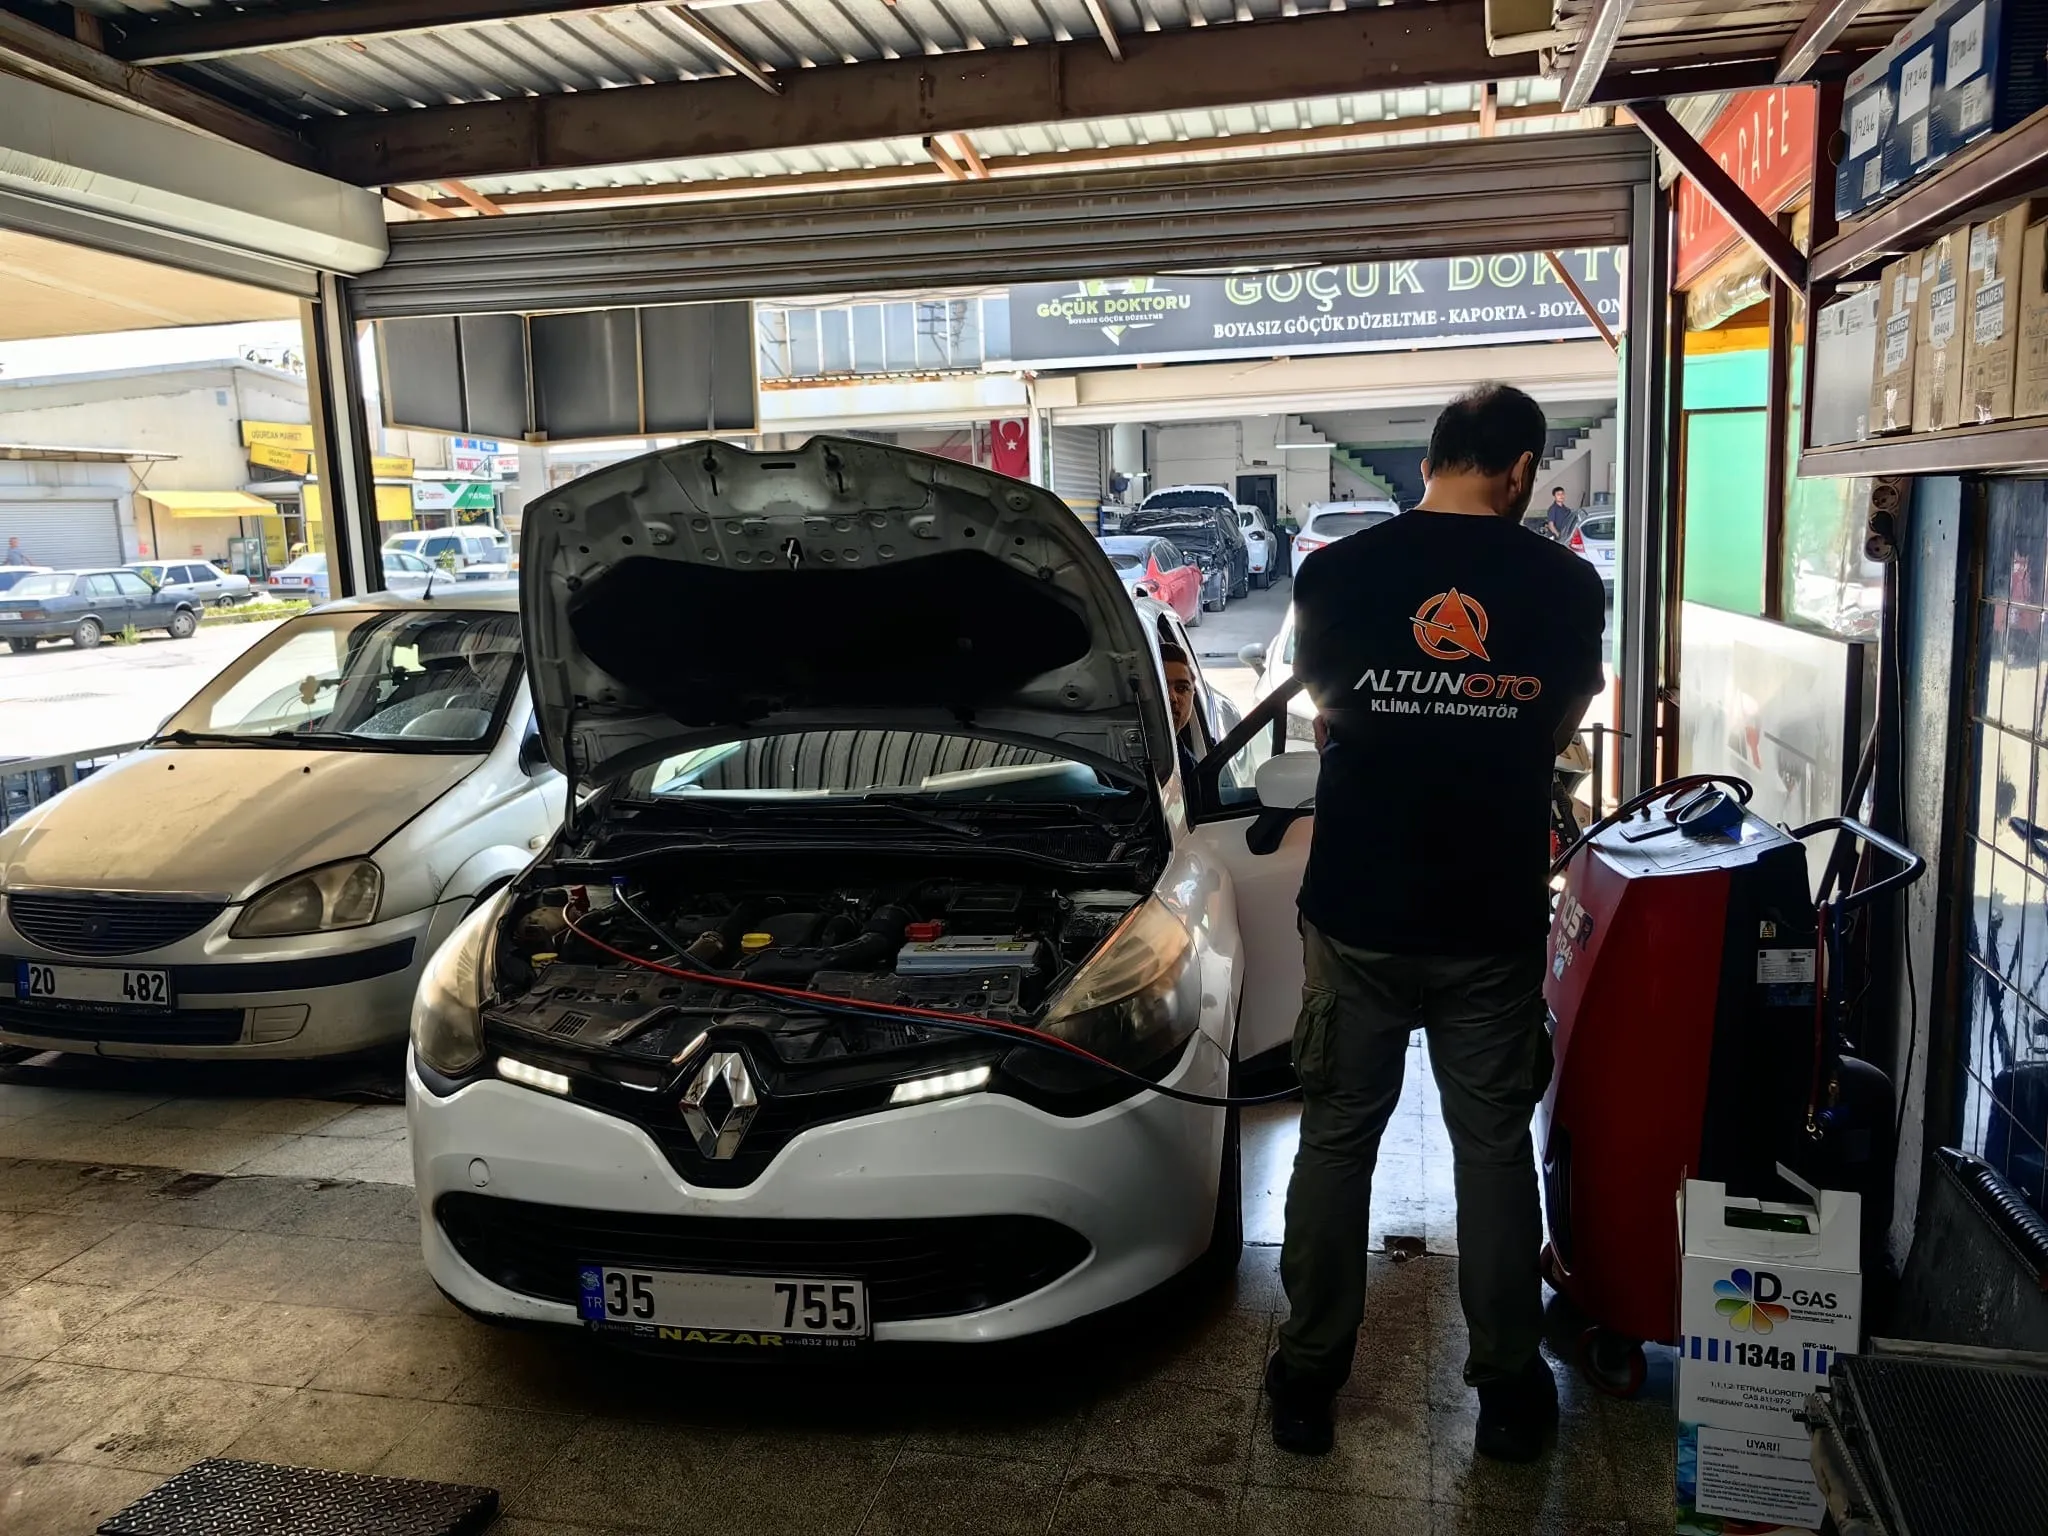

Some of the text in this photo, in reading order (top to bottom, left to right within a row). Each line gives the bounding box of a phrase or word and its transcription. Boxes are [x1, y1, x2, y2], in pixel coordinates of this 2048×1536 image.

[1036, 294, 1191, 320] GÖÇÜK DOKTORU
[1068, 313, 1164, 325] BOYASIZ GÖÇÜK DÜZELTME
[1213, 319, 1282, 338] BOYASIZ
[1284, 314, 1345, 337] GÖÇÜK
[1347, 310, 1437, 330] DÜZELTME
[1448, 305, 1528, 324] KAPORTA
[1371, 698, 1421, 715] KLİMA
[1434, 702, 1519, 719] RADYATÖR
[30, 966, 166, 1002] 20 482
[584, 1296, 603, 1308] TR
[605, 1272, 857, 1330] 35 755
[659, 1327, 784, 1346] NAZAR
[1735, 1342, 1796, 1372] 134a
[1742, 1393, 1759, 1402] CAS
